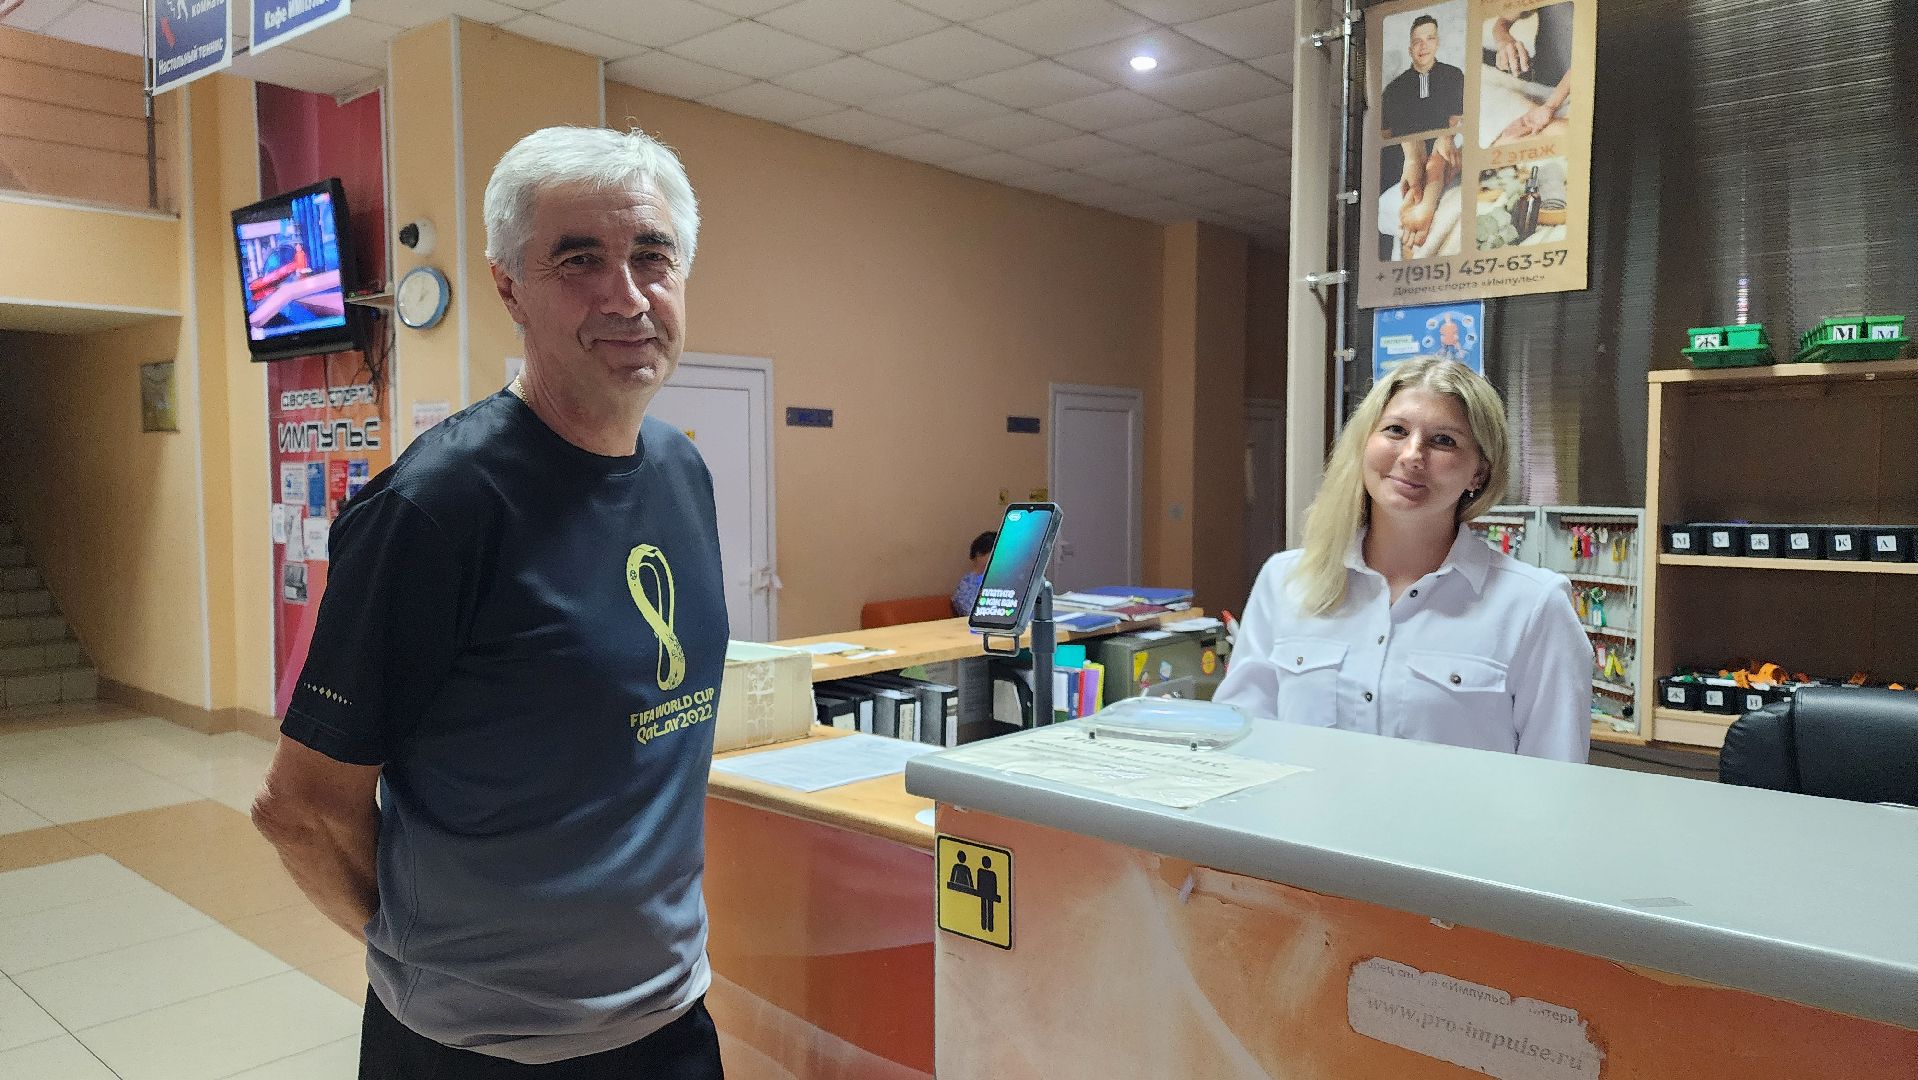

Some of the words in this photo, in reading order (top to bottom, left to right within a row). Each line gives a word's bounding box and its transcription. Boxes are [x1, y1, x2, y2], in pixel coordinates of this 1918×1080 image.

[1392, 263, 1452, 284] 7(915)
[1458, 249, 1569, 276] 457-63-57
[1836, 327, 1853, 340] М
[279, 418, 380, 450] ИМПУЛЬС
[630, 709, 655, 728] FIFA
[655, 694, 693, 720] WORLD
[693, 687, 715, 705] CUP
[1367, 999, 1583, 1071] www.pro-impulse.ru
